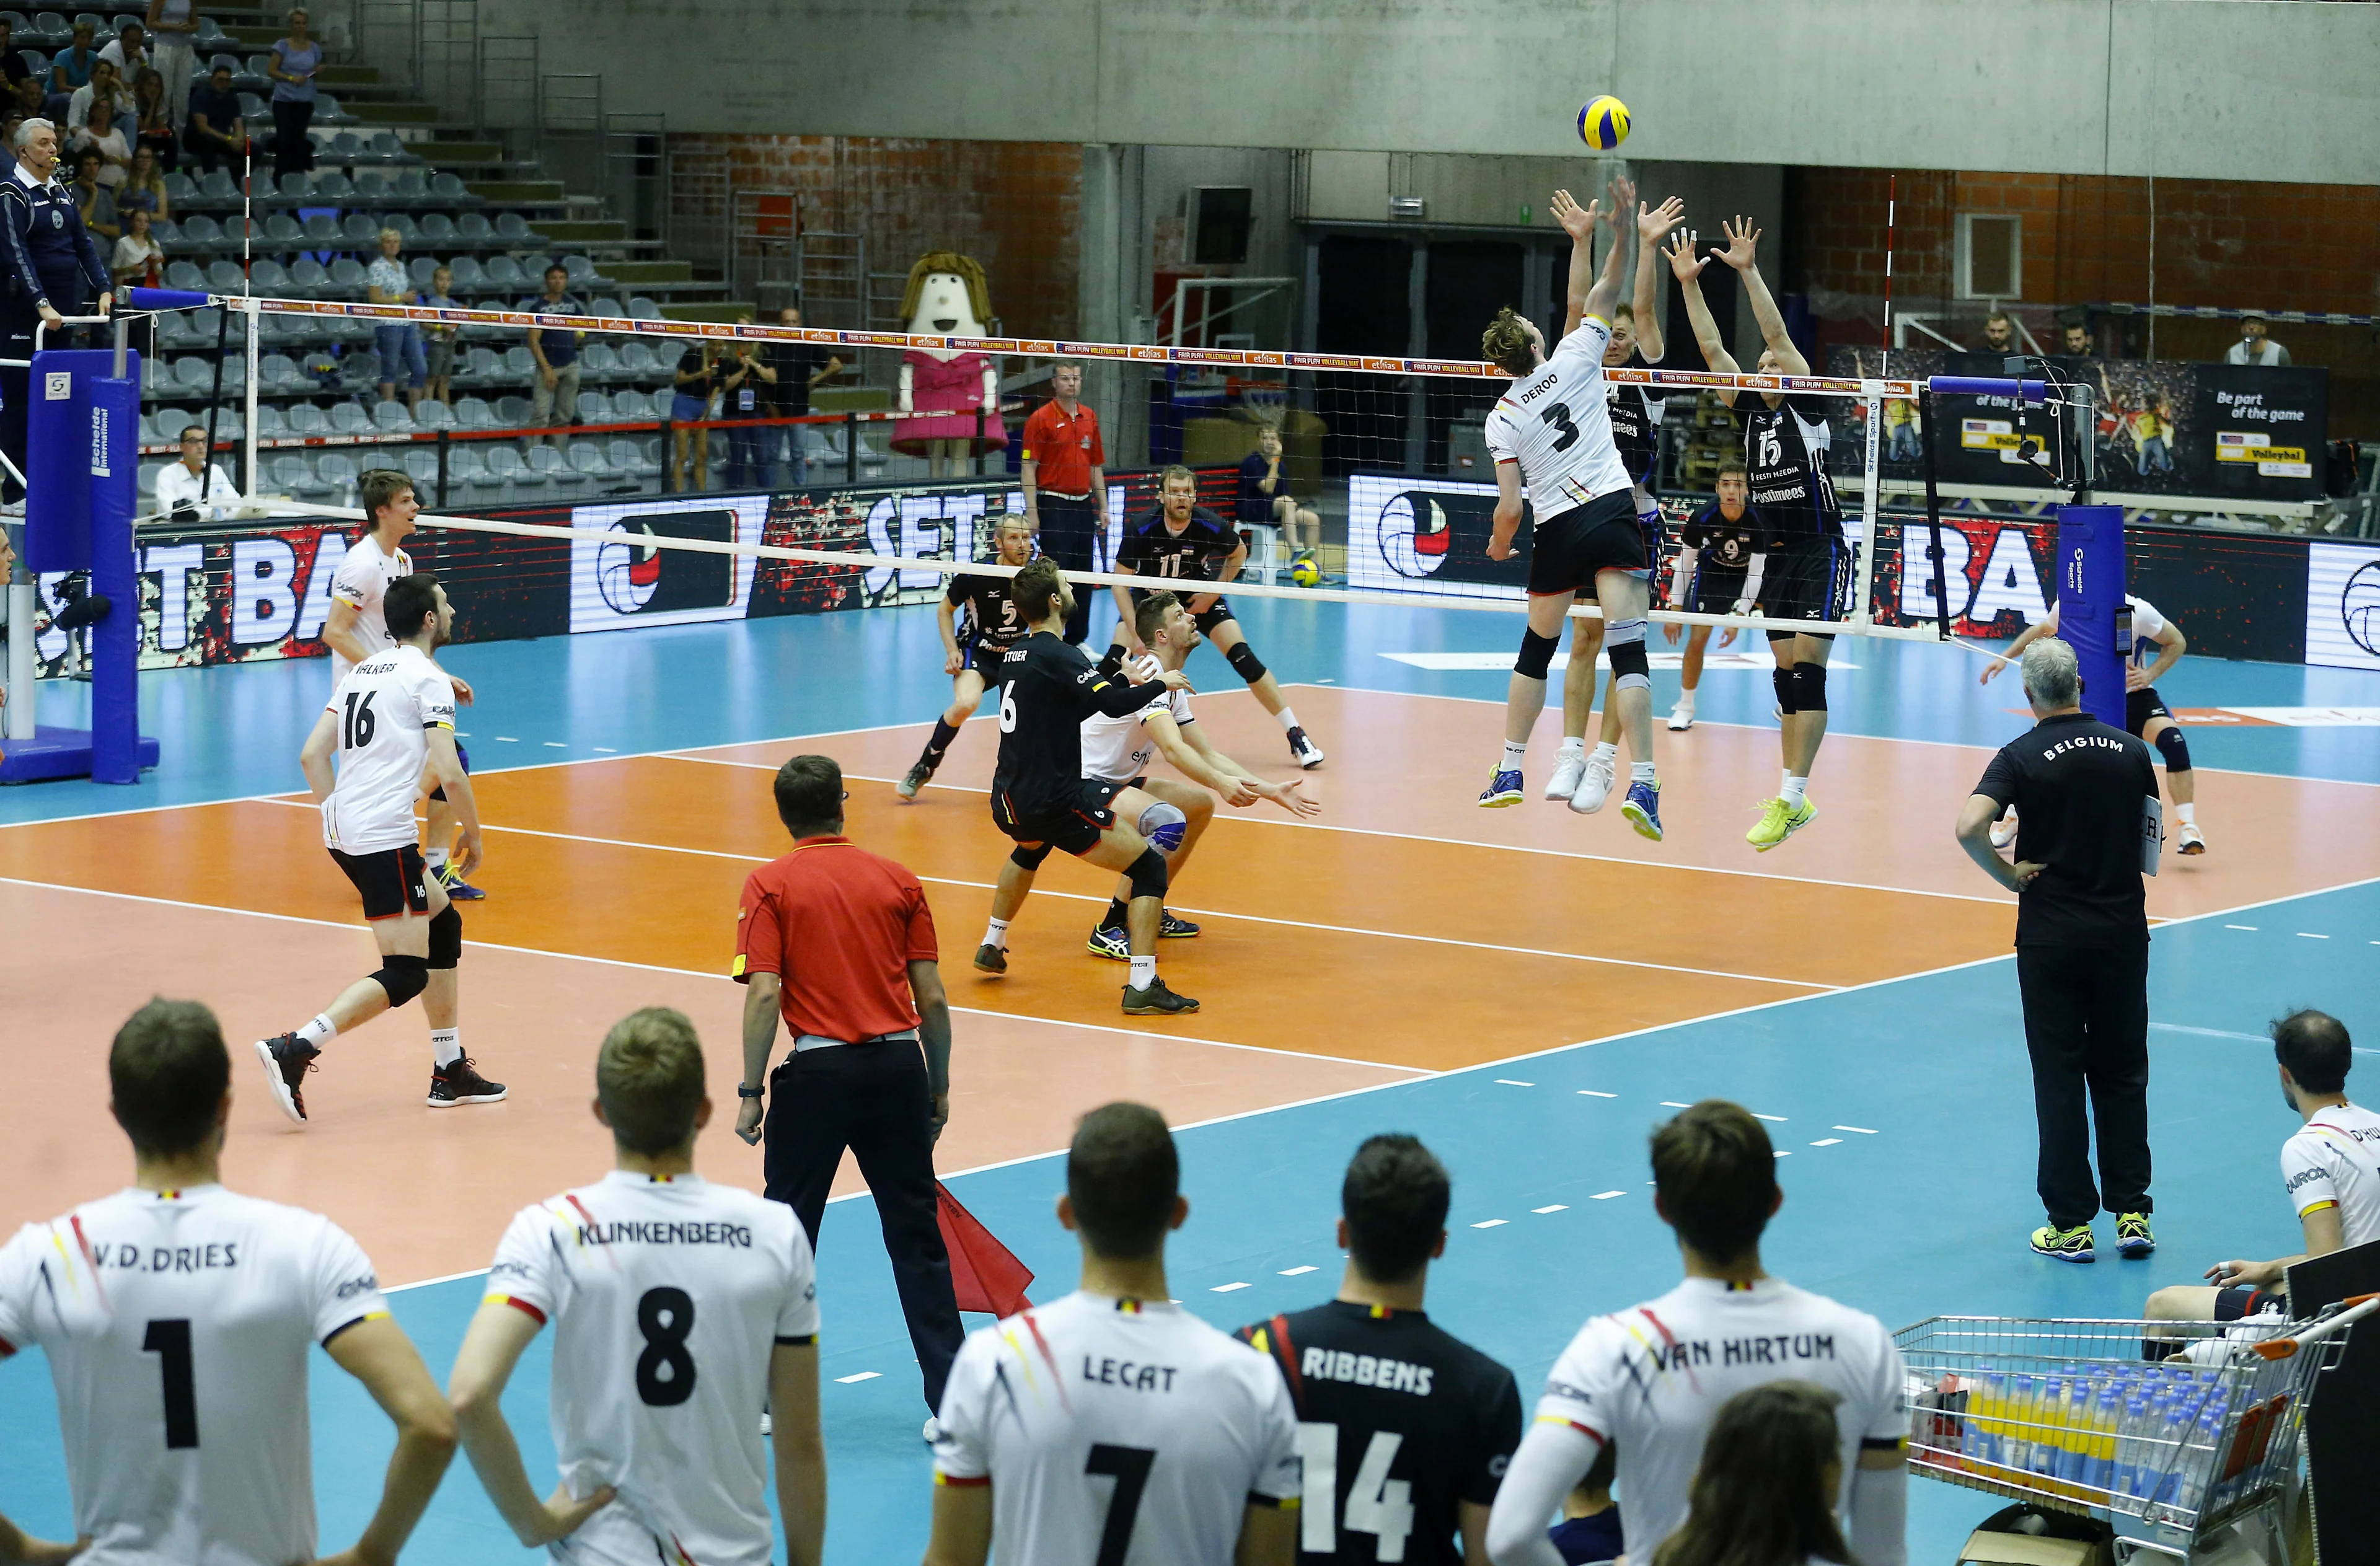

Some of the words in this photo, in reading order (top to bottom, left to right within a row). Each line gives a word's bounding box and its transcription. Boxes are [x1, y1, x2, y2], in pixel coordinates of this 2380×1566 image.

[708, 325, 729, 335] ethias
[810, 331, 832, 341] ethias
[917, 337, 938, 347] ethias
[1026, 341, 1049, 353] ethias
[1090, 347, 1115, 355] VOLLEYBALL
[1138, 347, 1161, 359] ethias
[1204, 353, 1230, 361] VOLLEYBALL
[1253, 353, 1277, 364] ethias
[1321, 358, 1348, 367] VOLLEYBALL
[1372, 359, 1396, 370] ethias
[1426, 364, 1440, 372] PLAY
[1441, 365, 1469, 373] VOLLEYBALL
[1618, 371, 1643, 382] ethias
[1691, 376, 1721, 384] VOLLEYBALL
[1745, 376, 1772, 387] ethias
[1806, 381, 1821, 389] PLAY
[1822, 382, 1852, 390] VOLLEYBALL
[1520, 374, 1558, 405] DEROO
[2216, 390, 2233, 404] Be
[2234, 393, 2263, 408] part
[2231, 406, 2247, 418] of
[2247, 407, 2268, 420] the
[2268, 410, 2305, 423] game
[92, 407, 101, 467] Schelde
[1541, 403, 1580, 453] 3
[100, 408, 108, 468] International
[1759, 428, 1782, 467] 15
[1867, 440, 1875, 473] Schelde
[1756, 472, 1772, 481] EESTI
[1773, 466, 1799, 478] MEEDIA
[1752, 486, 1806, 504] Postimees
[1724, 539, 1739, 560] 9
[1160, 553, 1181, 578] 11
[1001, 599, 1018, 626] 5
[1003, 650, 1028, 663] STUER
[355, 663, 398, 675] VALKIERS
[1000, 680, 1017, 734] 6
[345, 690, 377, 750] 16
[2043, 736, 2124, 762] BELGIUM
[1131, 750, 1151, 768] eni
[415, 885, 426, 898] 16
[2286, 1166, 2330, 1195] CAIROX
[579, 1221, 752, 1249] KLINKENBERG
[94, 1243, 237, 1274] V.D.DRIES
[636, 1287, 697, 1407] 8
[1651, 1339, 1712, 1371] VAN
[1723, 1334, 1836, 1367] HIRTUM
[1083, 1353, 1179, 1393] LECAT
[1302, 1347, 1434, 1397] RIBBENS
[143, 1319, 199, 1450] 1
[1295, 1422, 1416, 1563] 14
[1085, 1443, 1158, 1566] 7
